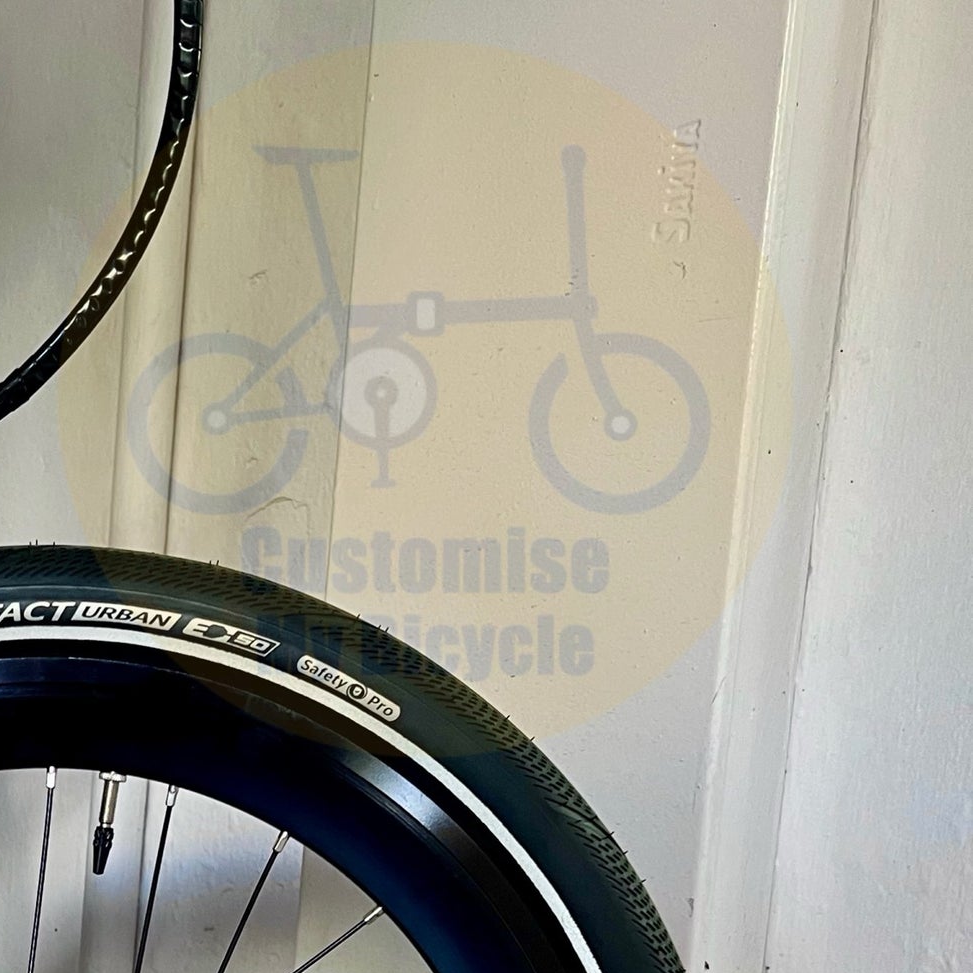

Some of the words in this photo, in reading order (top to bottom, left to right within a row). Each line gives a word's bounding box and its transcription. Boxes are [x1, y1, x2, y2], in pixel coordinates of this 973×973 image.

[79, 603, 175, 629] URBAN
[300, 657, 347, 691] Safety
[367, 695, 395, 718] Pro
